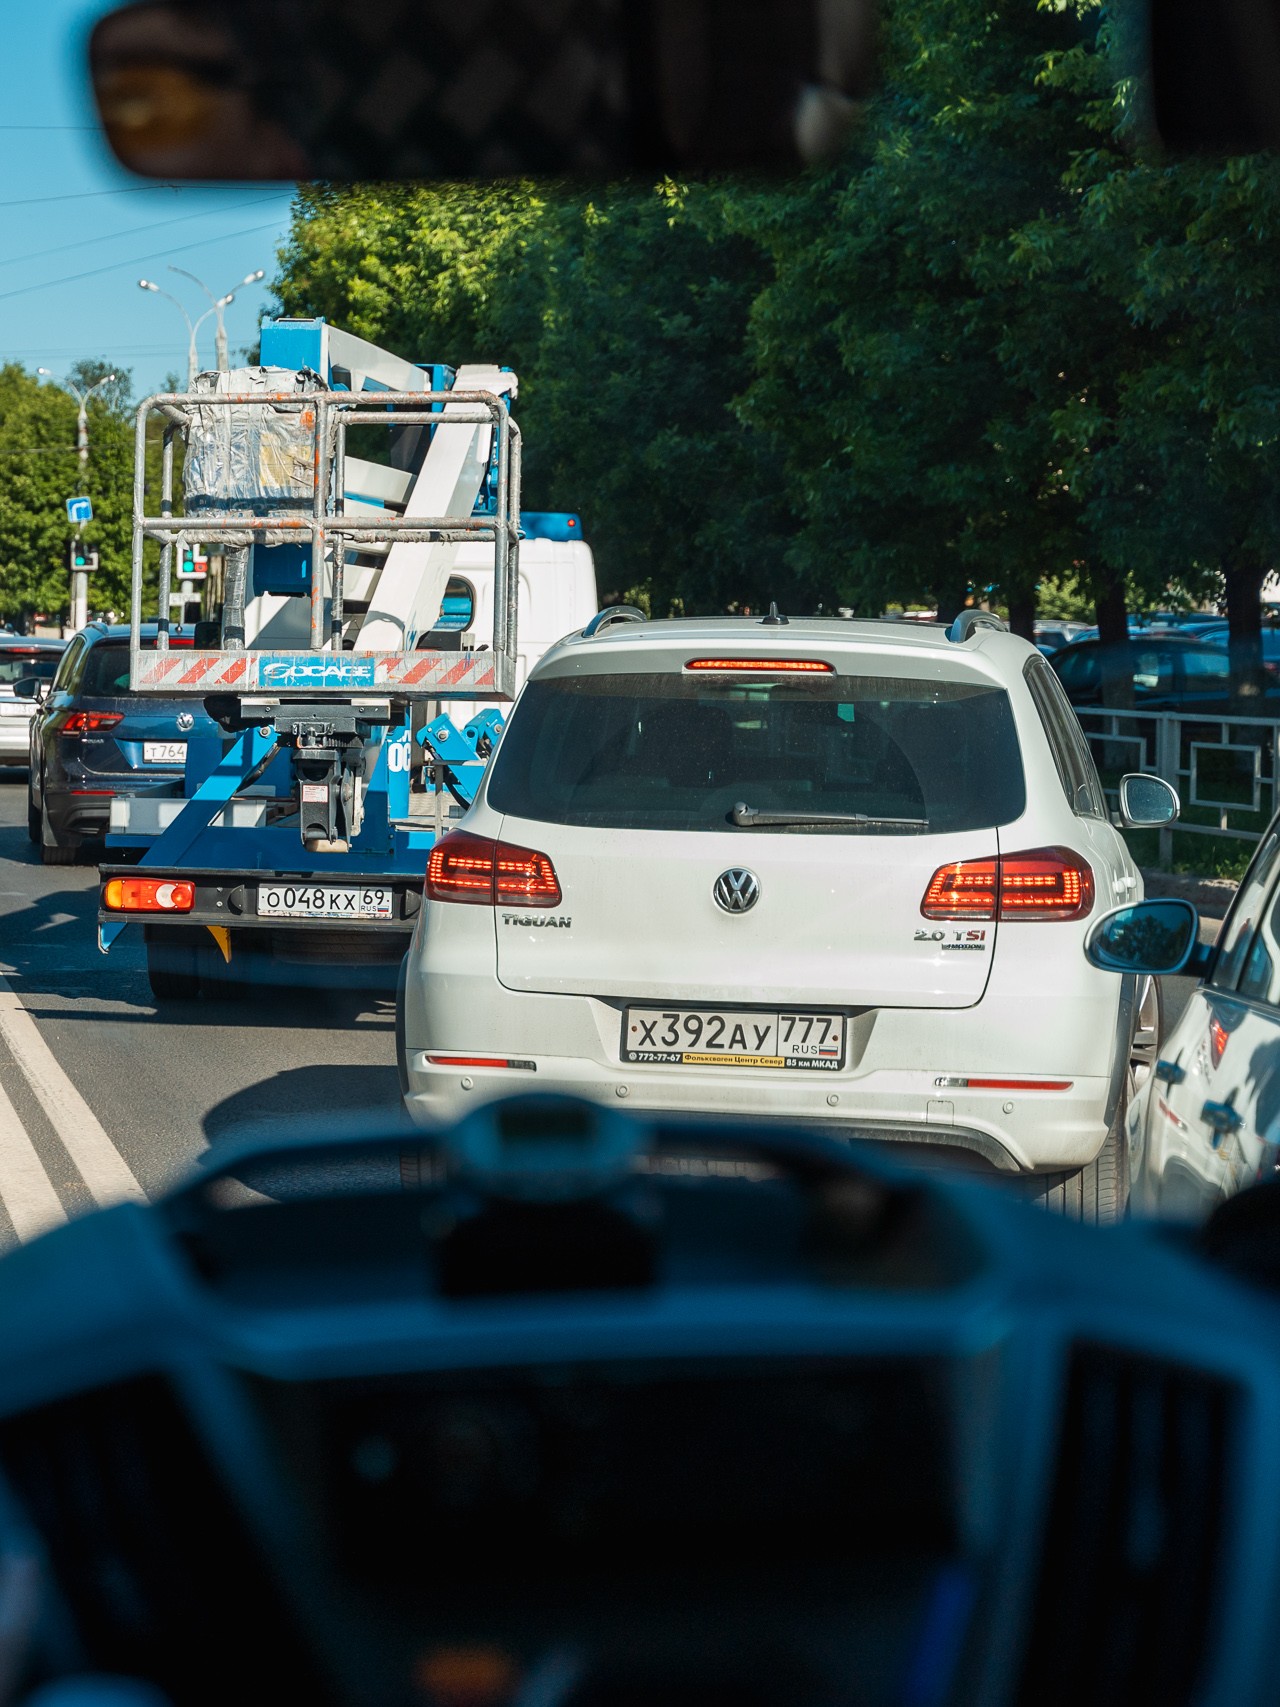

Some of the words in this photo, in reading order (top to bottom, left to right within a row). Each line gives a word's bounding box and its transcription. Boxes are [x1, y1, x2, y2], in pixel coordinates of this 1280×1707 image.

[363, 889, 385, 905] 69
[501, 913, 572, 928] TIGUAN
[953, 930, 986, 941] TSI
[781, 1016, 833, 1044] 777
[792, 1045, 818, 1055] RUS
[638, 1053, 681, 1062] 772-77-67
[684, 1054, 734, 1064] Фольксваген
[734, 1056, 758, 1065] Центр
[760, 1057, 783, 1066] Север
[786, 1059, 796, 1067] 85
[811, 1060, 838, 1069] МКАД
